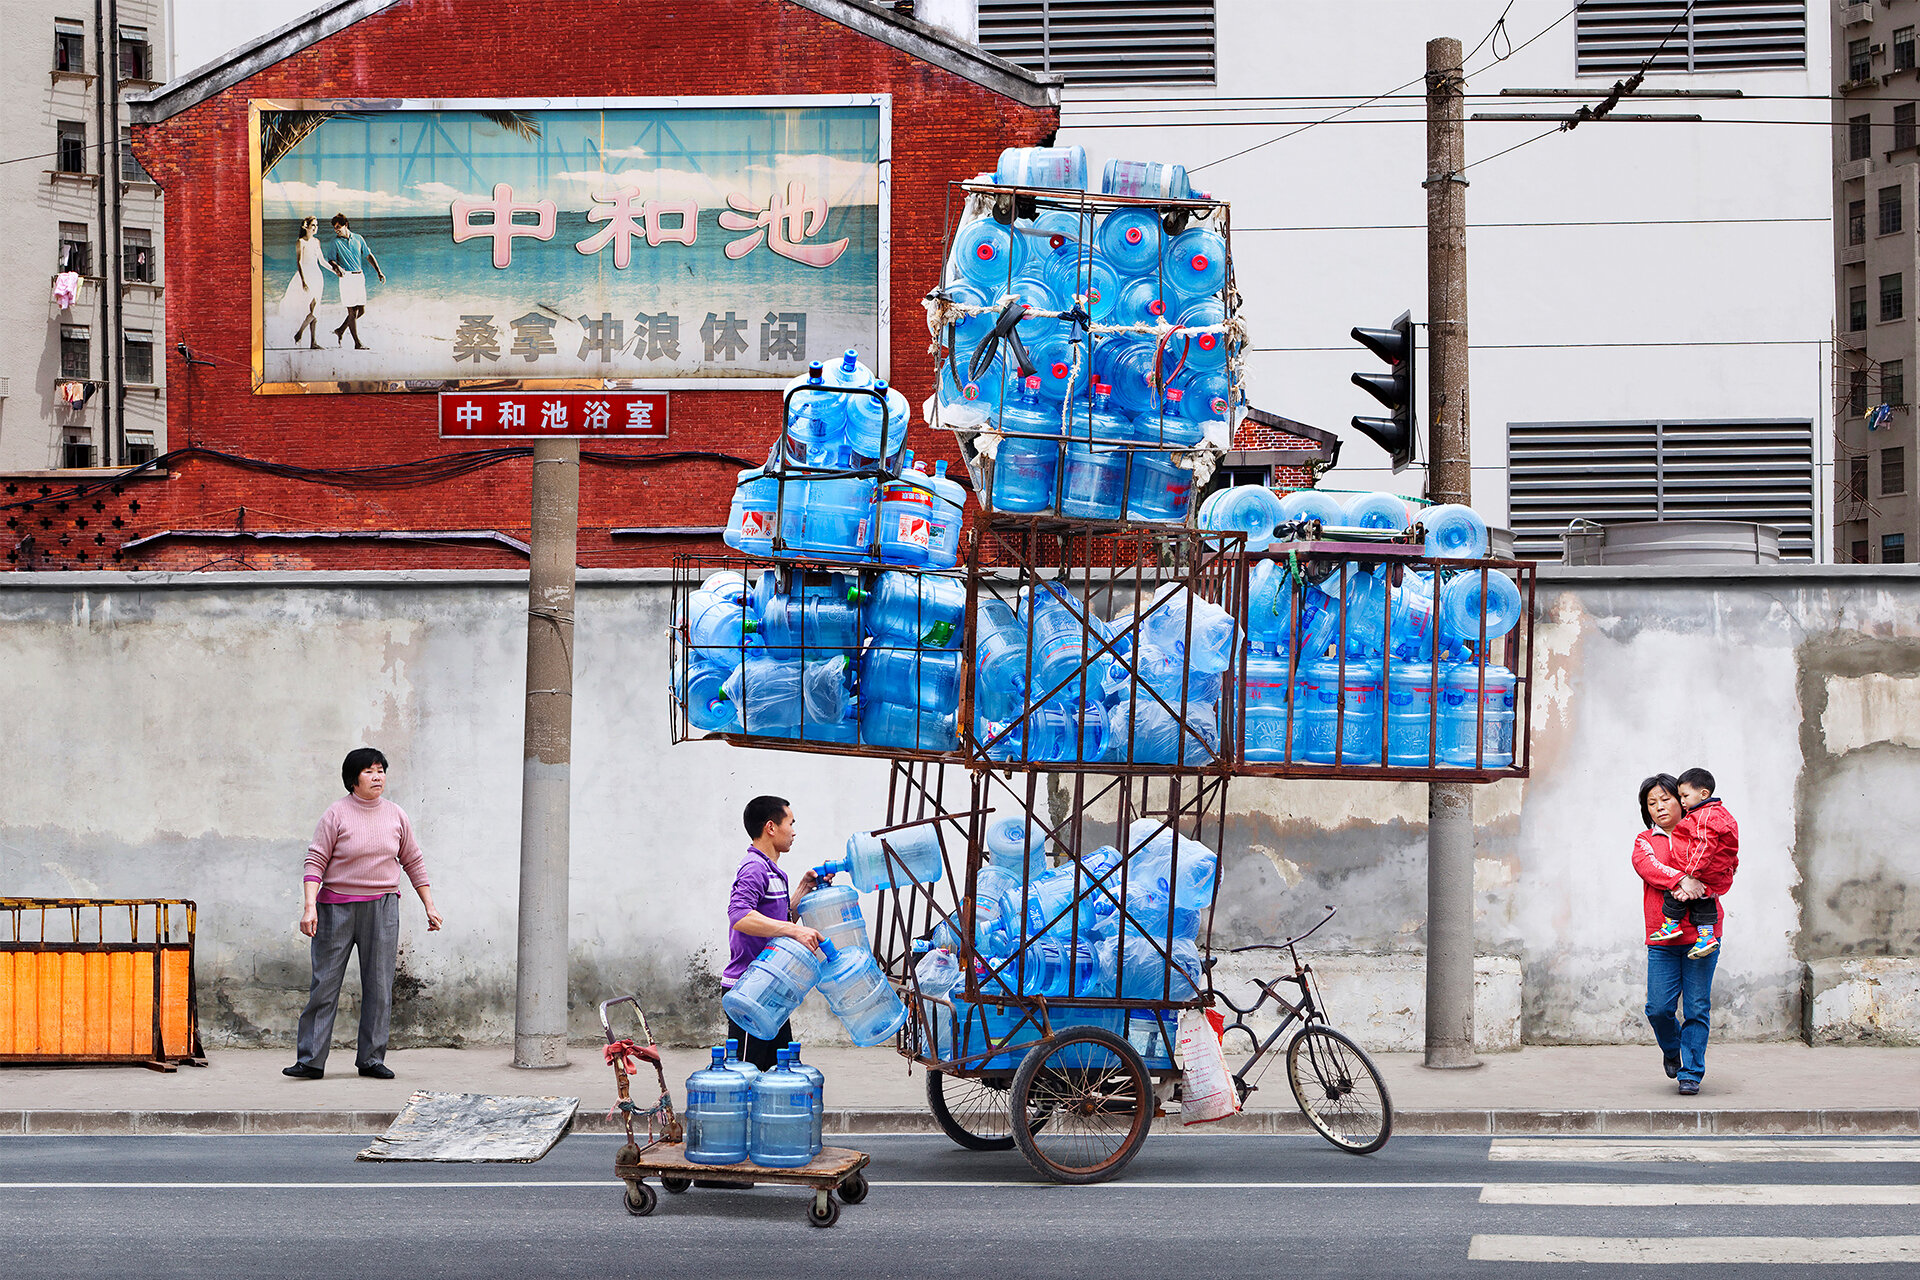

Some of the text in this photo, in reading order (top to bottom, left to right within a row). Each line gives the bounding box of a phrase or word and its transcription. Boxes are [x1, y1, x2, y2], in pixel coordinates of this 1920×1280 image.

[451, 181, 850, 270] 中和池
[456, 400, 654, 430] 中和池浴室
